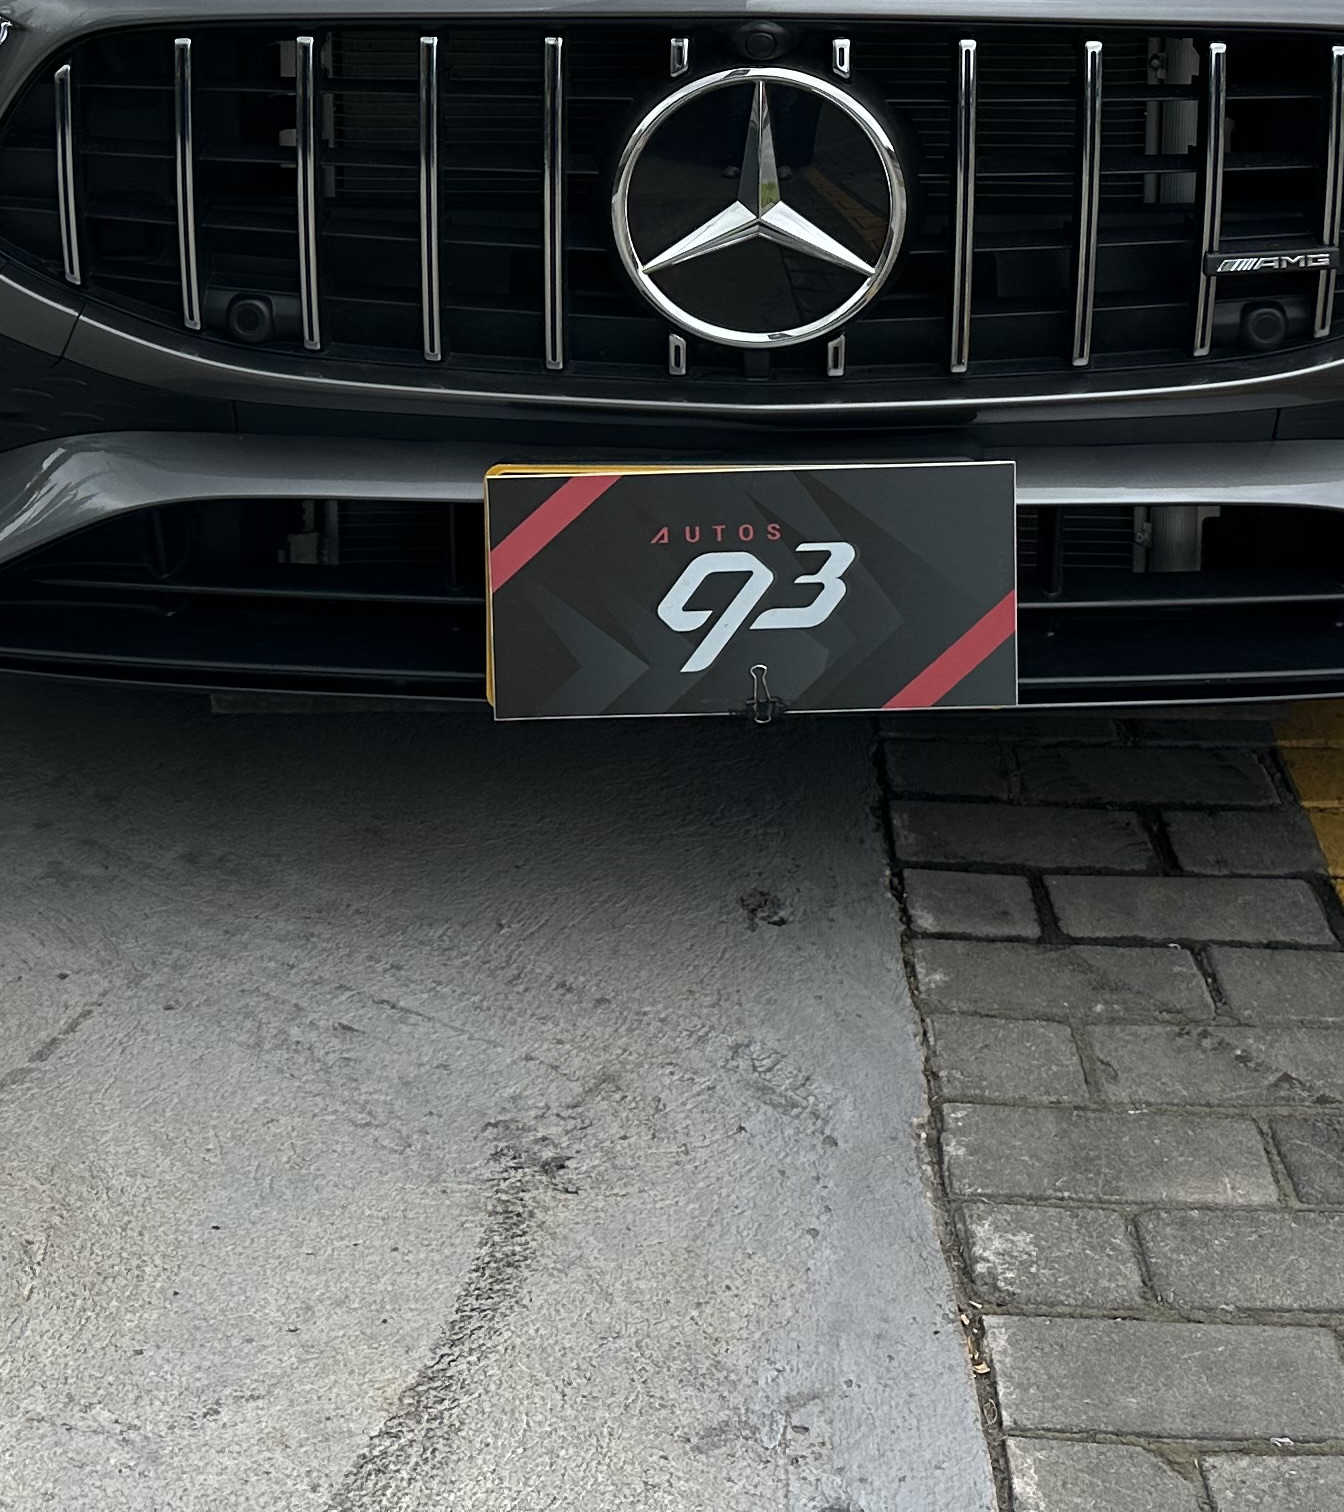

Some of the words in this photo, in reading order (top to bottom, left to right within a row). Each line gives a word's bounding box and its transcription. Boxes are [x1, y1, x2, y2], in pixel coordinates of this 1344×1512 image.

[1254, 253, 1330, 270] AMG
[650, 523, 781, 544] AUTOS
[657, 542, 856, 673] 93
